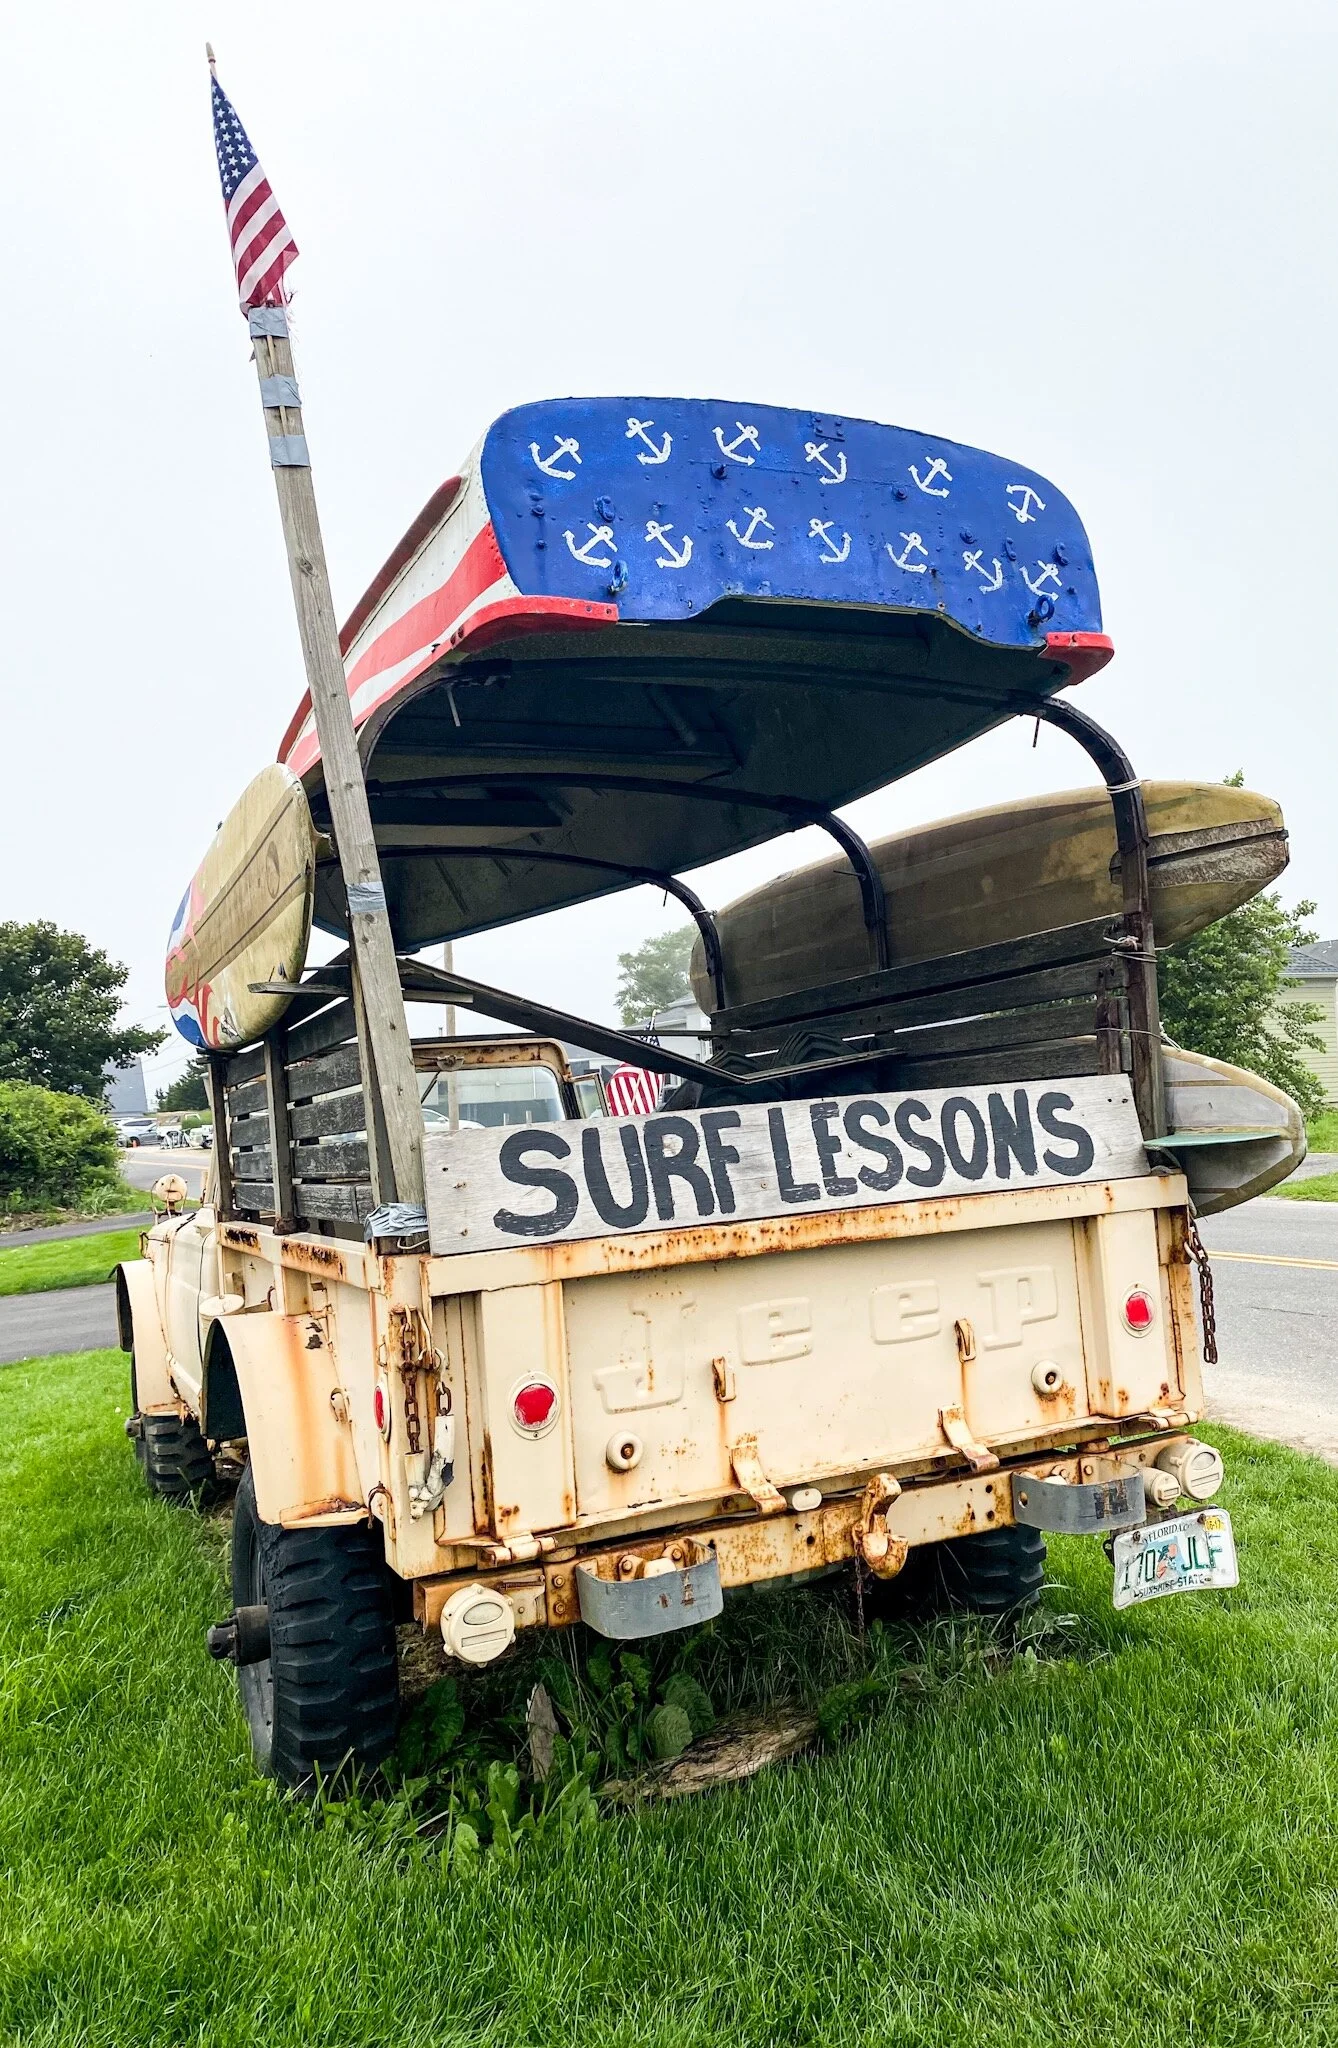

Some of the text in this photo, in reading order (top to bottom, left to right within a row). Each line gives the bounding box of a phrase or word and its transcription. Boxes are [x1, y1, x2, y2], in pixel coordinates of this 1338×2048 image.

[494, 1088, 1096, 1237] SURF LESSONS
[592, 1265, 1060, 1414] Jeep
[1181, 1535, 1223, 1572] JLF
